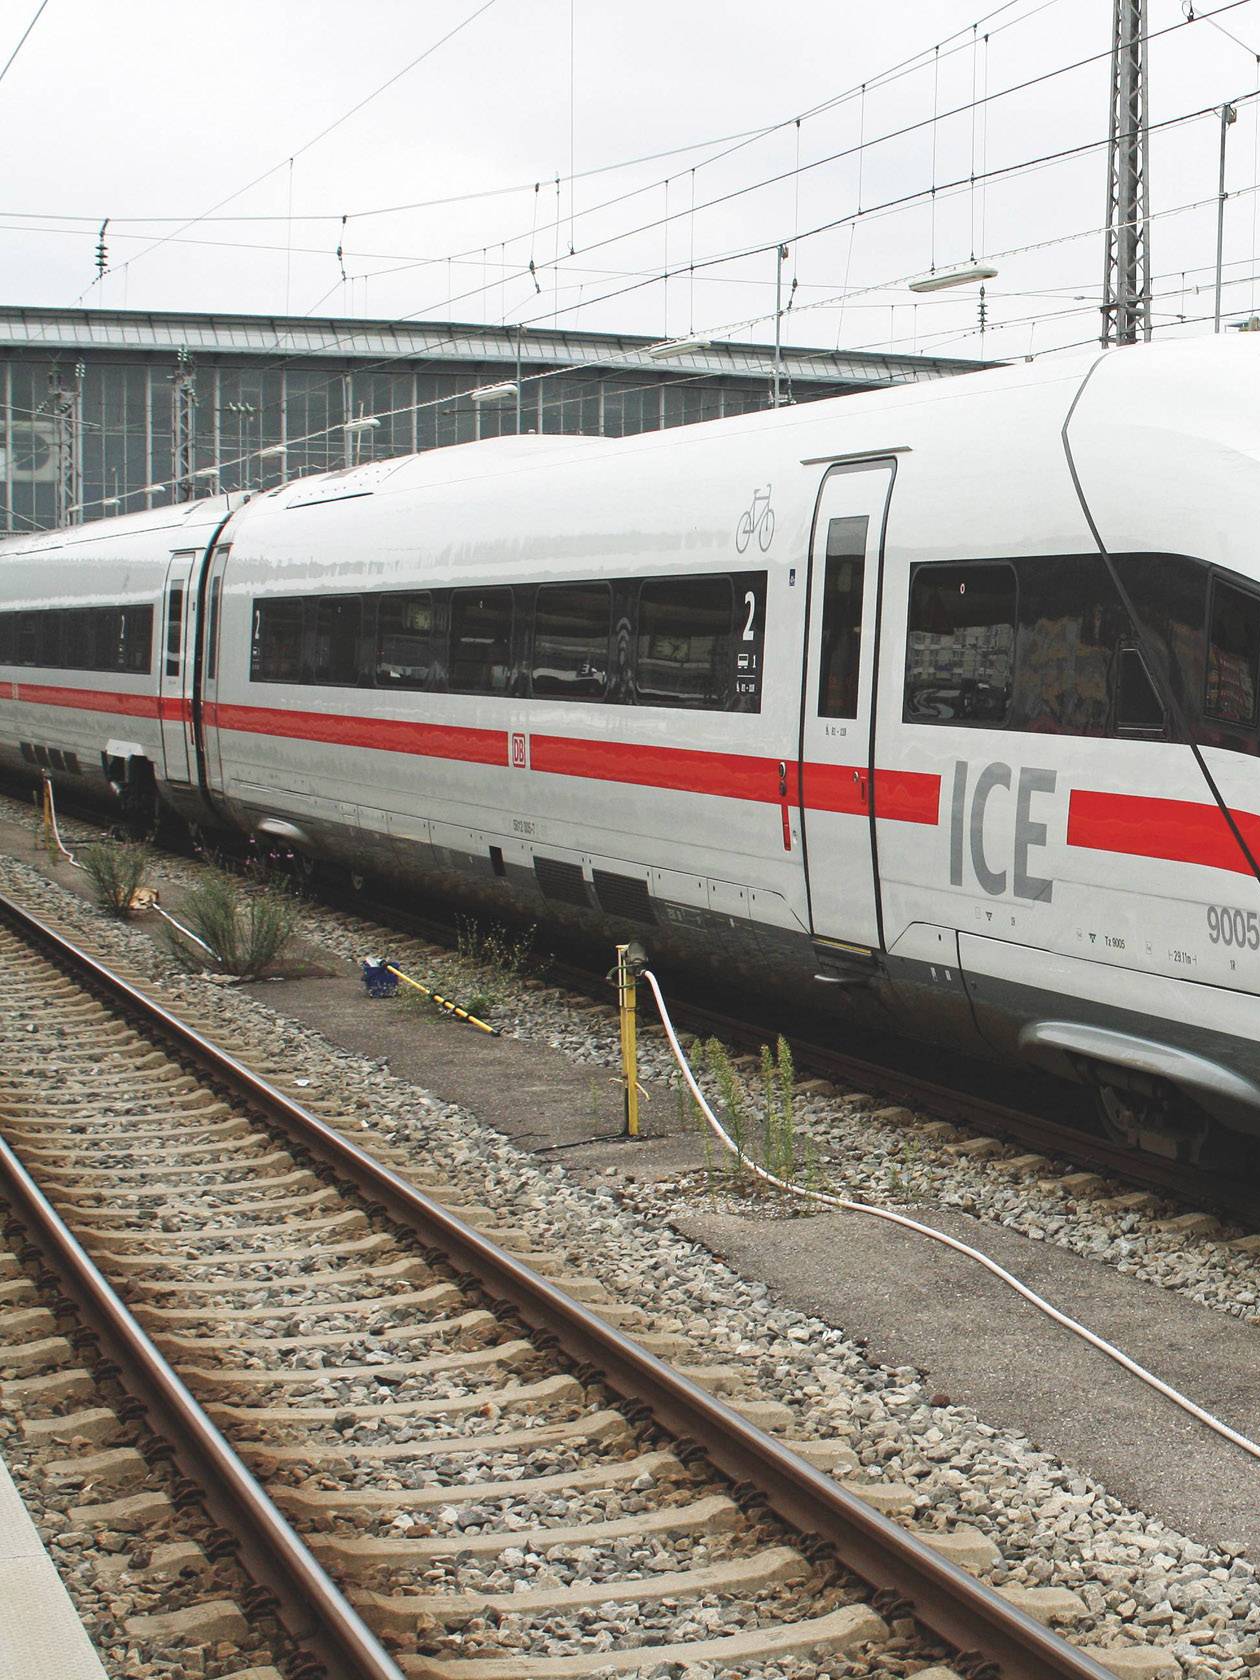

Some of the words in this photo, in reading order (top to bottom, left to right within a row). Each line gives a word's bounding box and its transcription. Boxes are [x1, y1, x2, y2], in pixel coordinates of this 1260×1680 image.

[743, 590, 756, 641] 2
[513, 735, 525, 765] DB
[950, 760, 1058, 904] ICE
[1112, 937, 1126, 950] 9005
[1207, 905, 1260, 951] 9005
